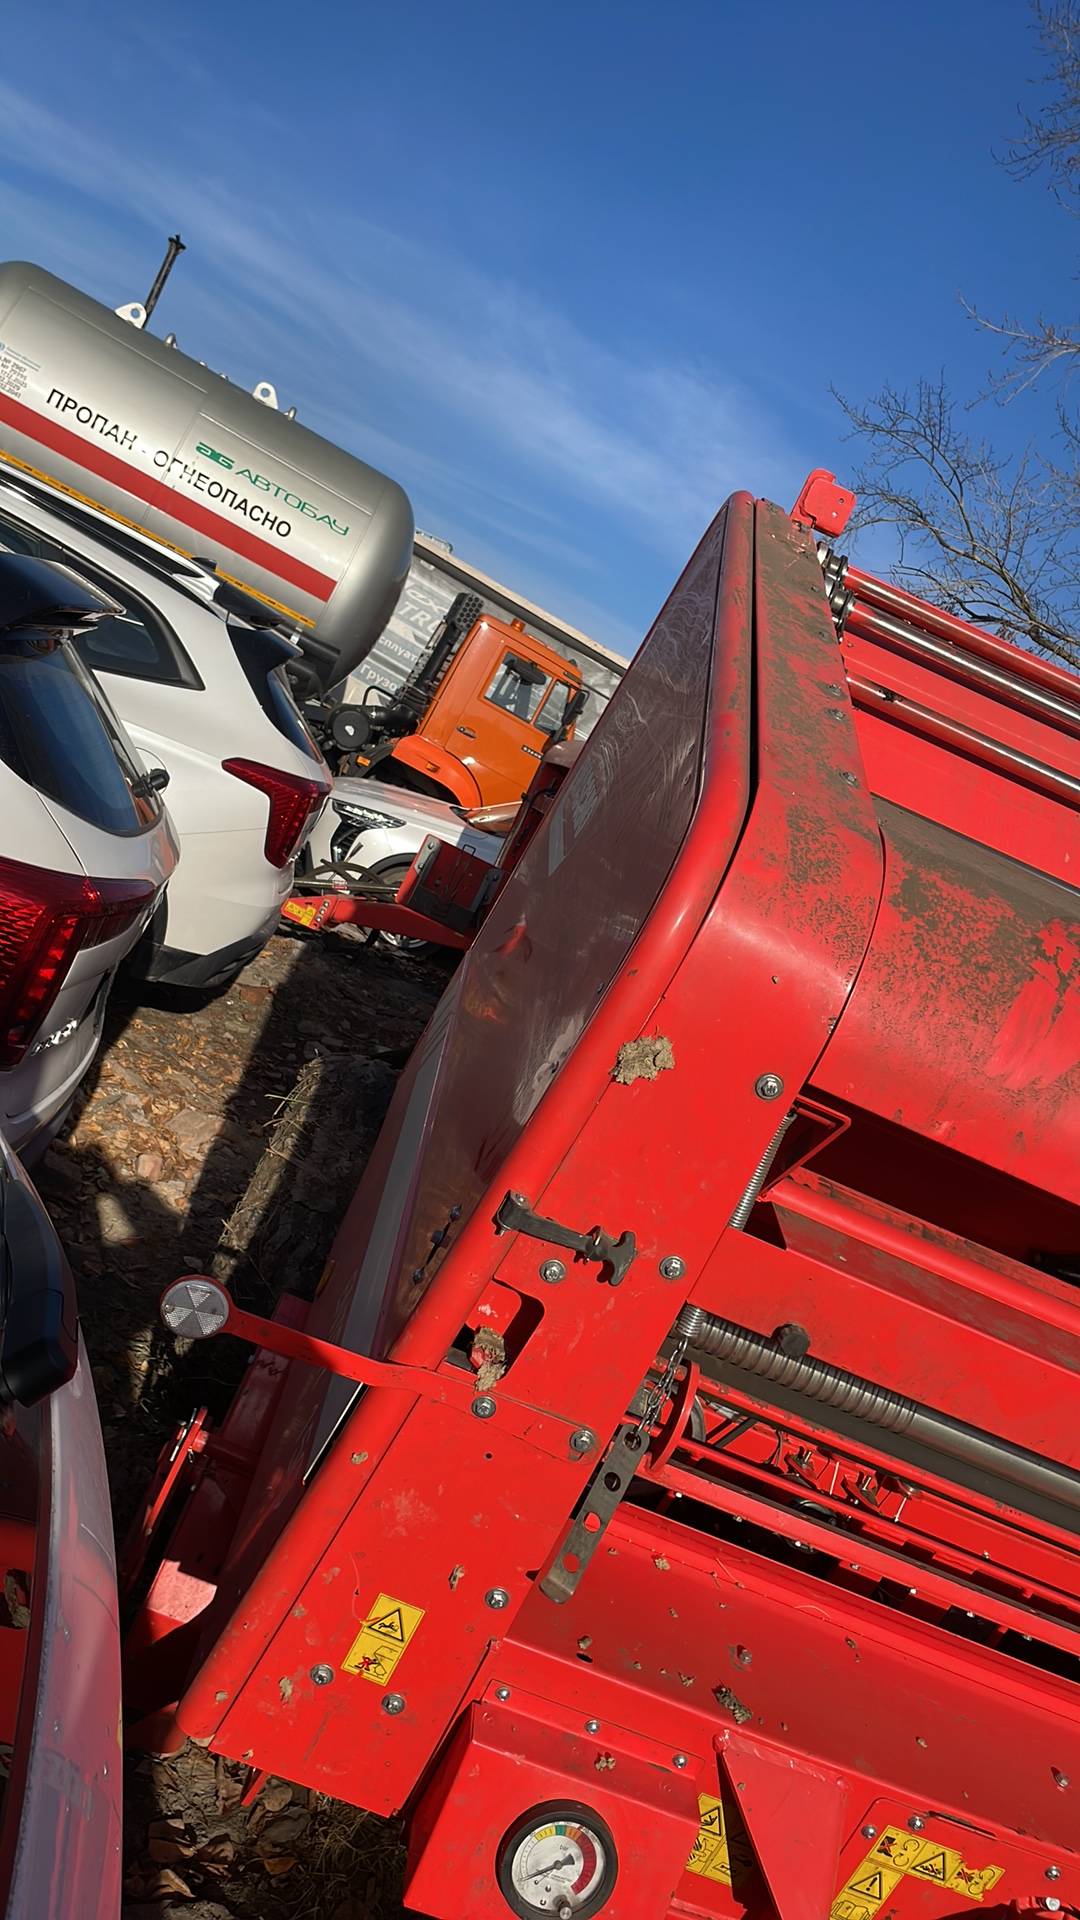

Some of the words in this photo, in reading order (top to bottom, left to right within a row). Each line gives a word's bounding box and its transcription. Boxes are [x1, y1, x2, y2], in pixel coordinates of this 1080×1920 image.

[46, 388, 138, 450] ПРОПАН
[153, 450, 292, 537] ОГНЕОПАСНО
[235, 468, 349, 536] АВТОБАУ
